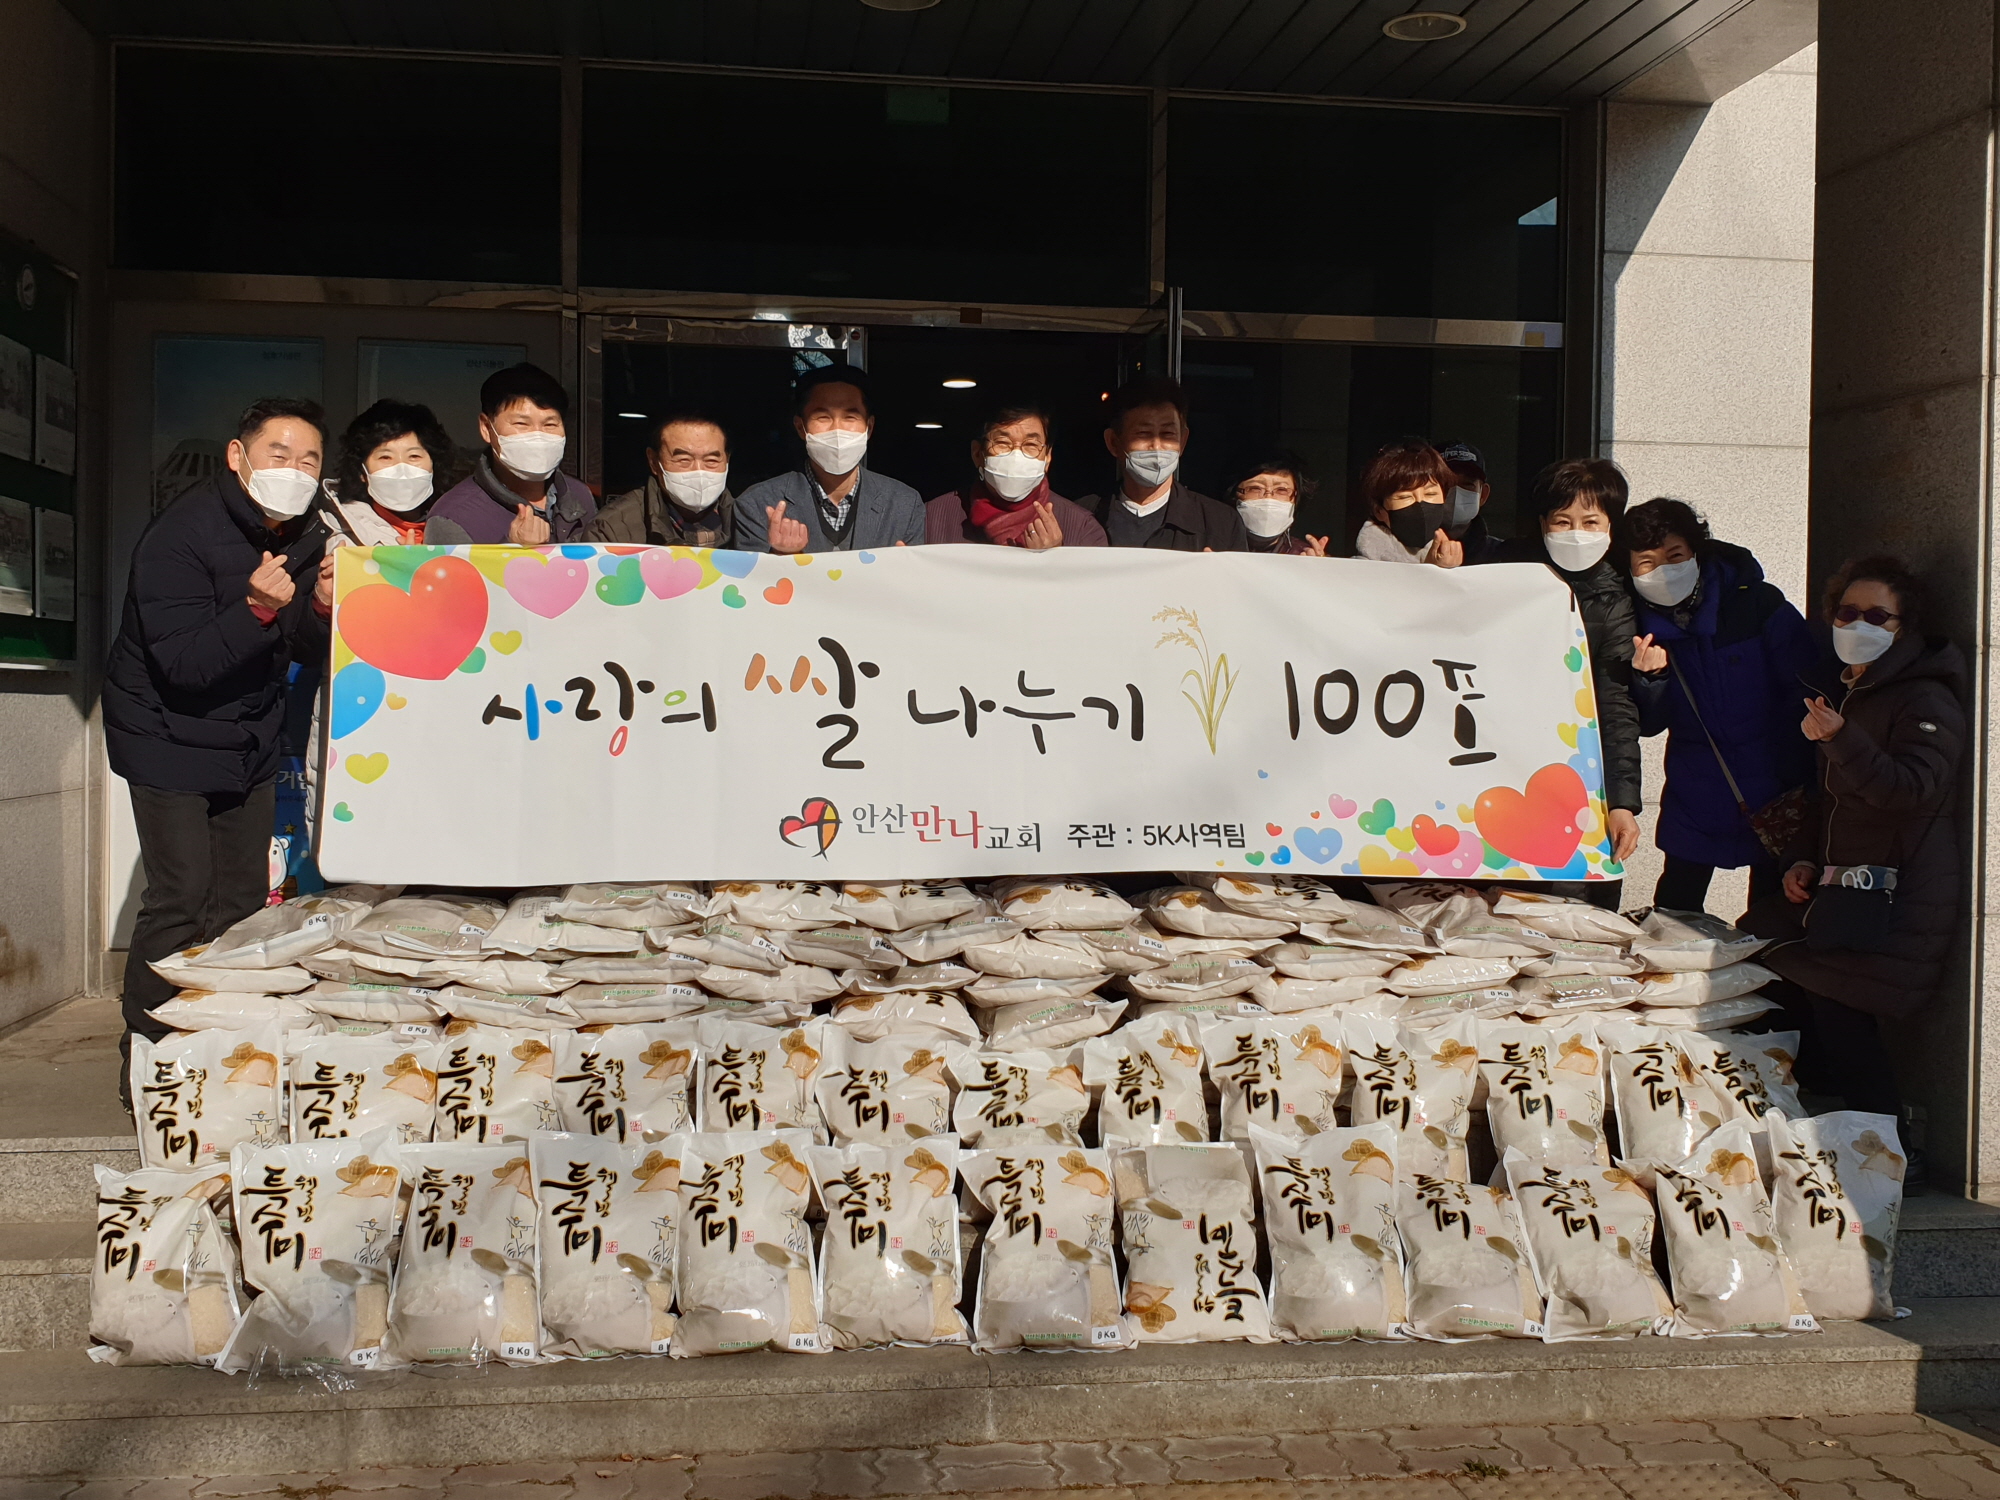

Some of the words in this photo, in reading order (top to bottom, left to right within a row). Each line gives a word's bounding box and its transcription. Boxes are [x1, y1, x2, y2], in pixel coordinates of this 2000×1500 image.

[482, 661, 717, 756] 사랑의
[745, 637, 880, 769] 쌀
[908, 671, 1143, 754] 나누기
[1285, 659, 1496, 766] 100포
[851, 801, 1042, 853] 안산만나교회
[1068, 823, 1116, 848] 주관
[1144, 823, 1245, 848] 5K사역팀
[295, 1062, 348, 1139] 특수
[343, 1071, 365, 1120] 웰빙
[476, 1052, 496, 1107] 웰빙
[451, 1173, 475, 1216] 웰빙
[595, 1167, 618, 1218] 웰빙
[1024, 1158, 1046, 1205] 웰빙
[539, 1161, 603, 1265] 특수미
